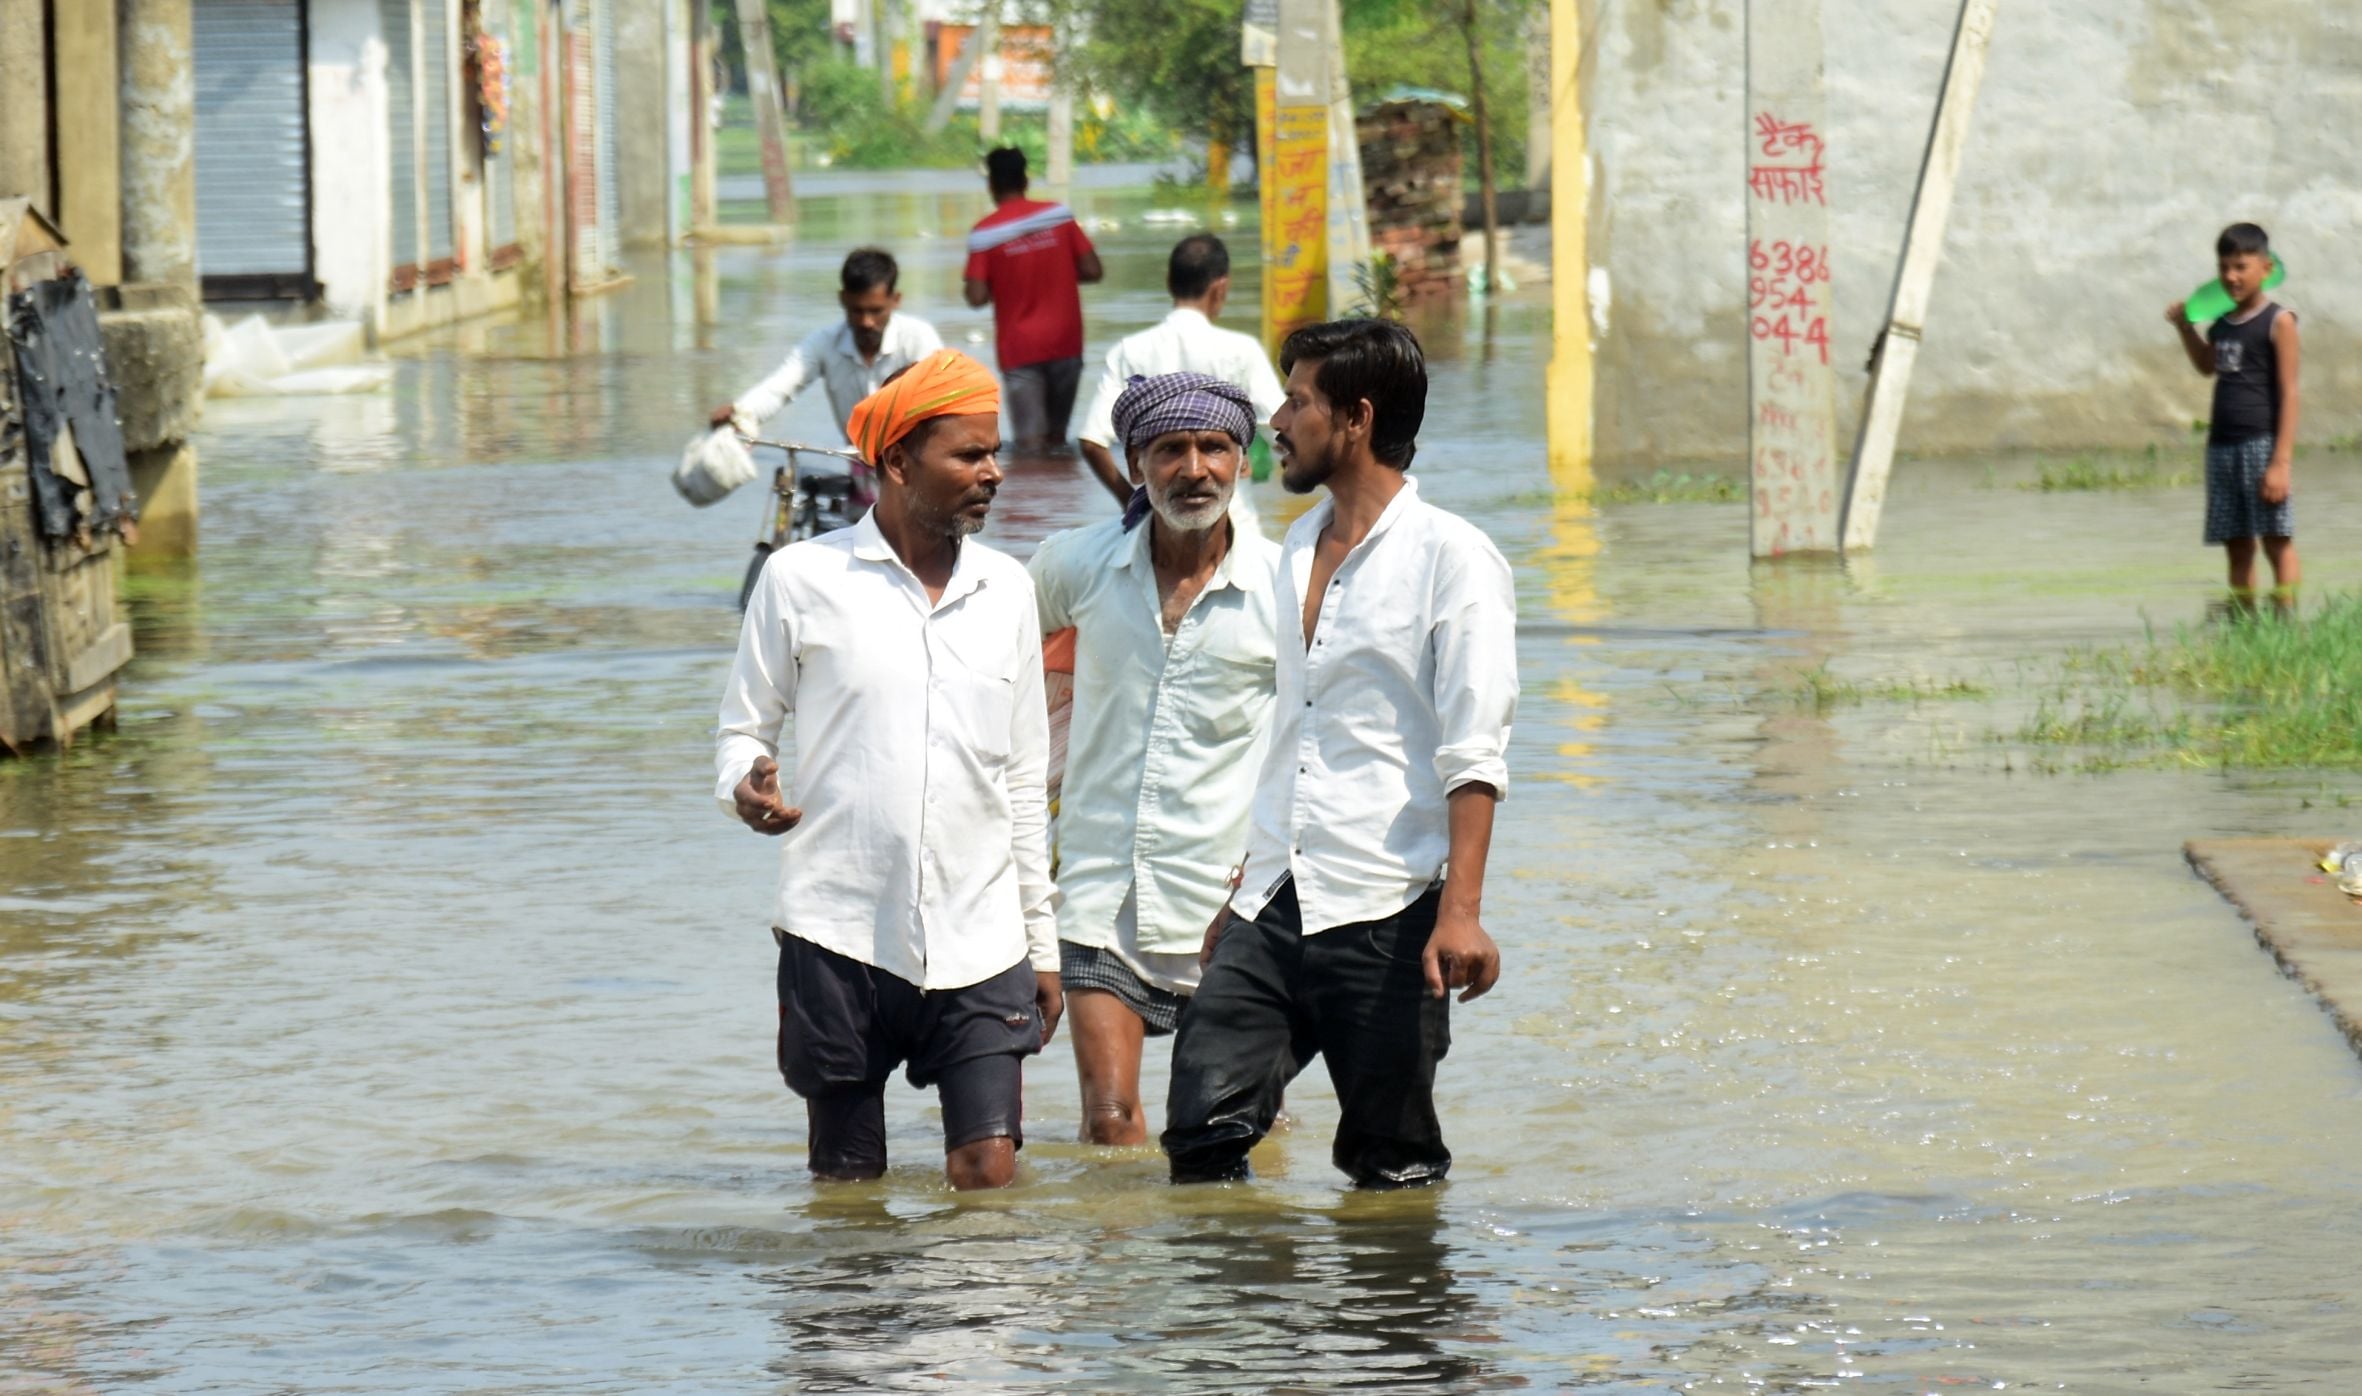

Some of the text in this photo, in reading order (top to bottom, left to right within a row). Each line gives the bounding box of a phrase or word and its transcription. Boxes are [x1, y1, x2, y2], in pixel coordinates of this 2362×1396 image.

[1749, 239, 1830, 285] 6386
[1749, 276, 1817, 322] 954
[1750, 313, 1829, 366] 044
